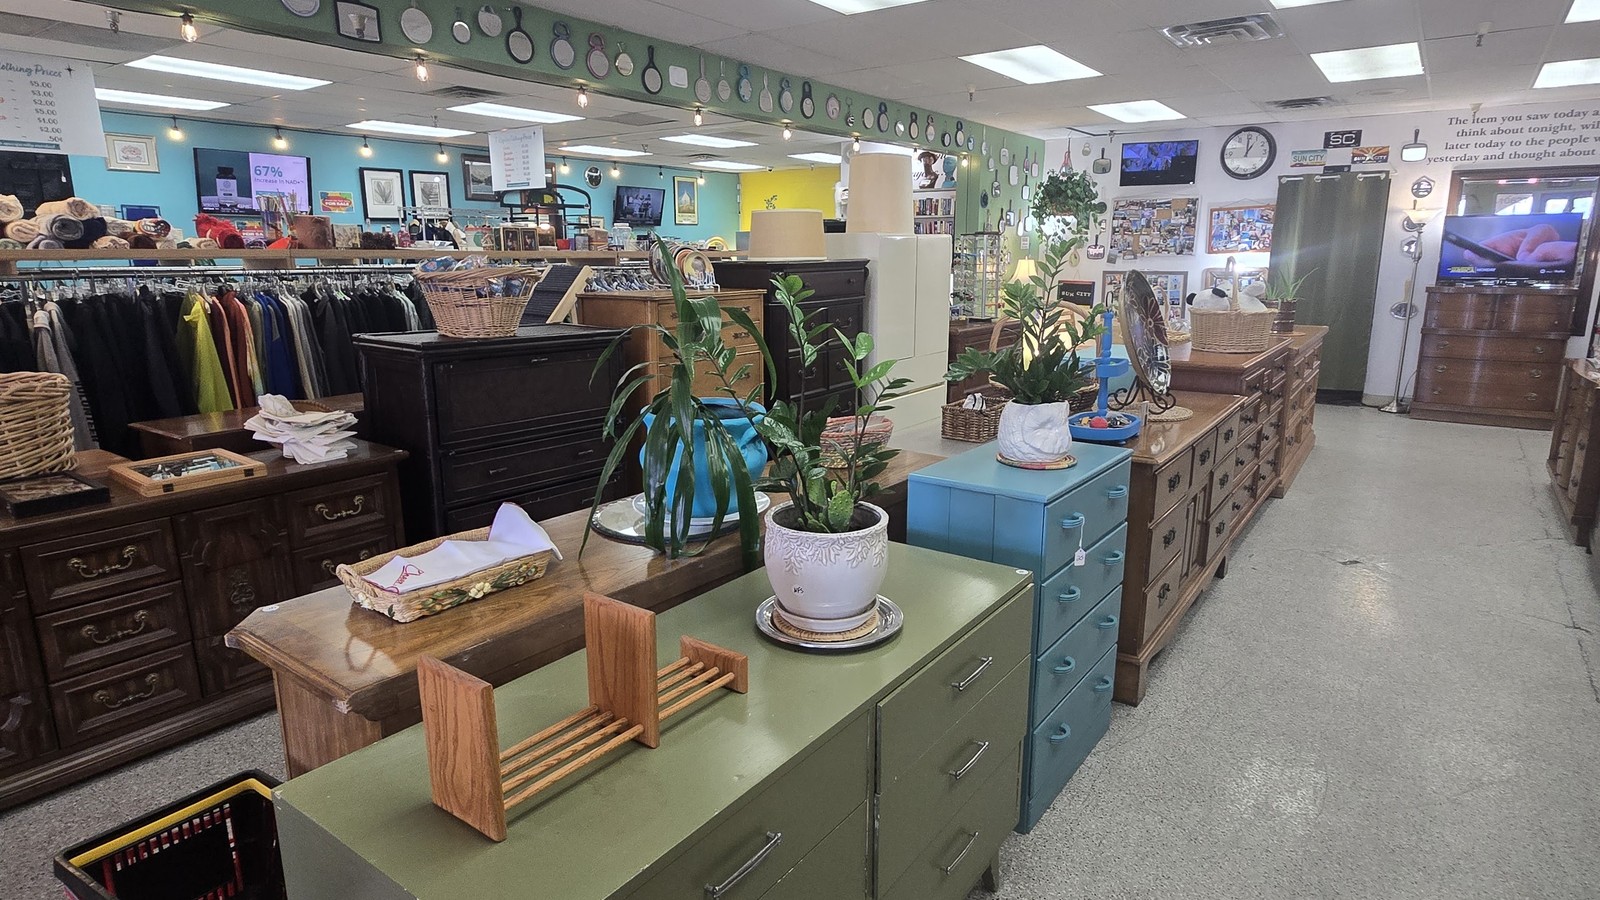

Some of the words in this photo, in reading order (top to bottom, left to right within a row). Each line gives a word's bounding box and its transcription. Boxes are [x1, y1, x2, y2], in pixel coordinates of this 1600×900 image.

[34, 64, 62, 78] Prices
[30, 80, 52, 89] $5.00
[31, 90, 54, 98] $3.00
[33, 99, 56, 107] $2.00
[35, 108, 57, 116] $5.00
[1448, 116, 1469, 126] The
[1472, 115, 1497, 124] item
[1500, 114, 1523, 125] you
[1526, 113, 1550, 121] saw
[1554, 109, 1589, 120] today
[37, 117, 59, 125] $1.00
[40, 126, 62, 134] $2.00
[1456, 127, 1487, 137] think
[1490, 126, 1524, 136] about
[1528, 122, 1576, 135] tonight,
[1581, 120, 1600, 130] wil
[1329, 133, 1356, 145] SC
[1445, 142, 1471, 150] later
[1474, 140, 1506, 151] today
[1526, 137, 1545, 146] the
[1548, 135, 1590, 147] people
[1427, 153, 1480, 165] yesterday
[1483, 151, 1505, 161] and
[1509, 149, 1556, 161] thought
[1559, 148, 1596, 157] about
[254, 165, 283, 178] 67%
